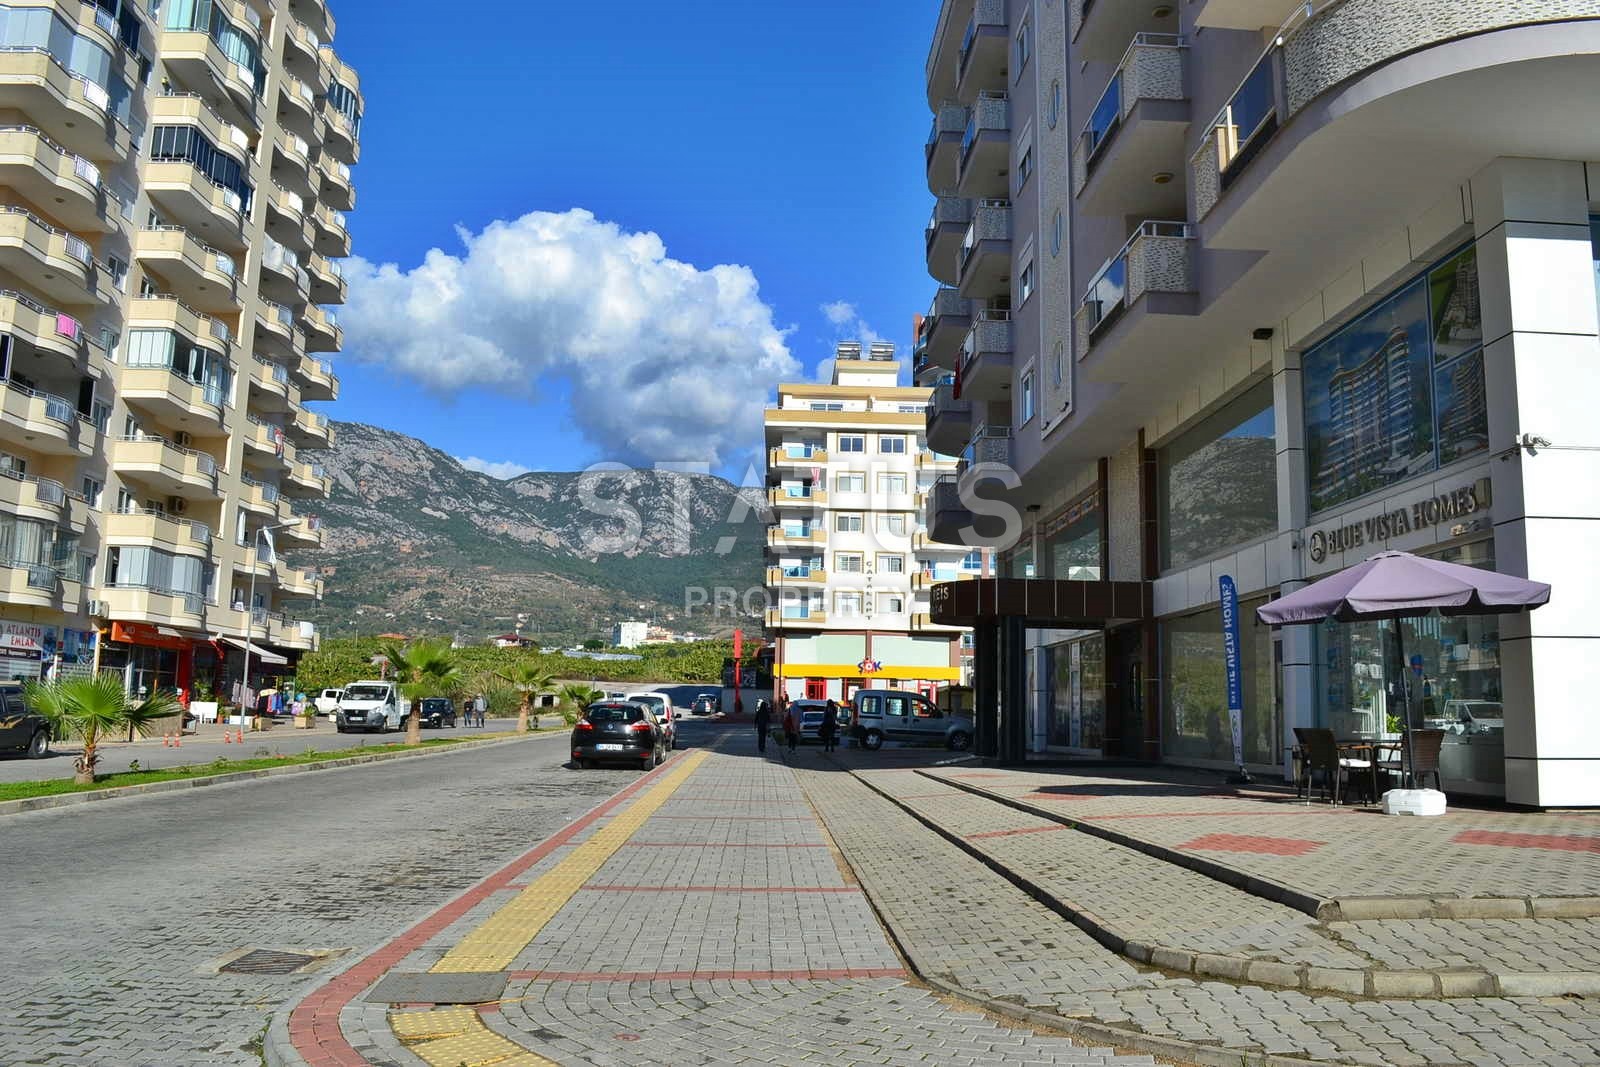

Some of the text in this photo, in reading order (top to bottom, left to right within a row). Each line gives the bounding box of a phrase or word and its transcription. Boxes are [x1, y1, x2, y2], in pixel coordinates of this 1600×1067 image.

[1328, 484, 1479, 554] BLUE VISTA HOMES
[11, 636, 35, 647] EMLAK
